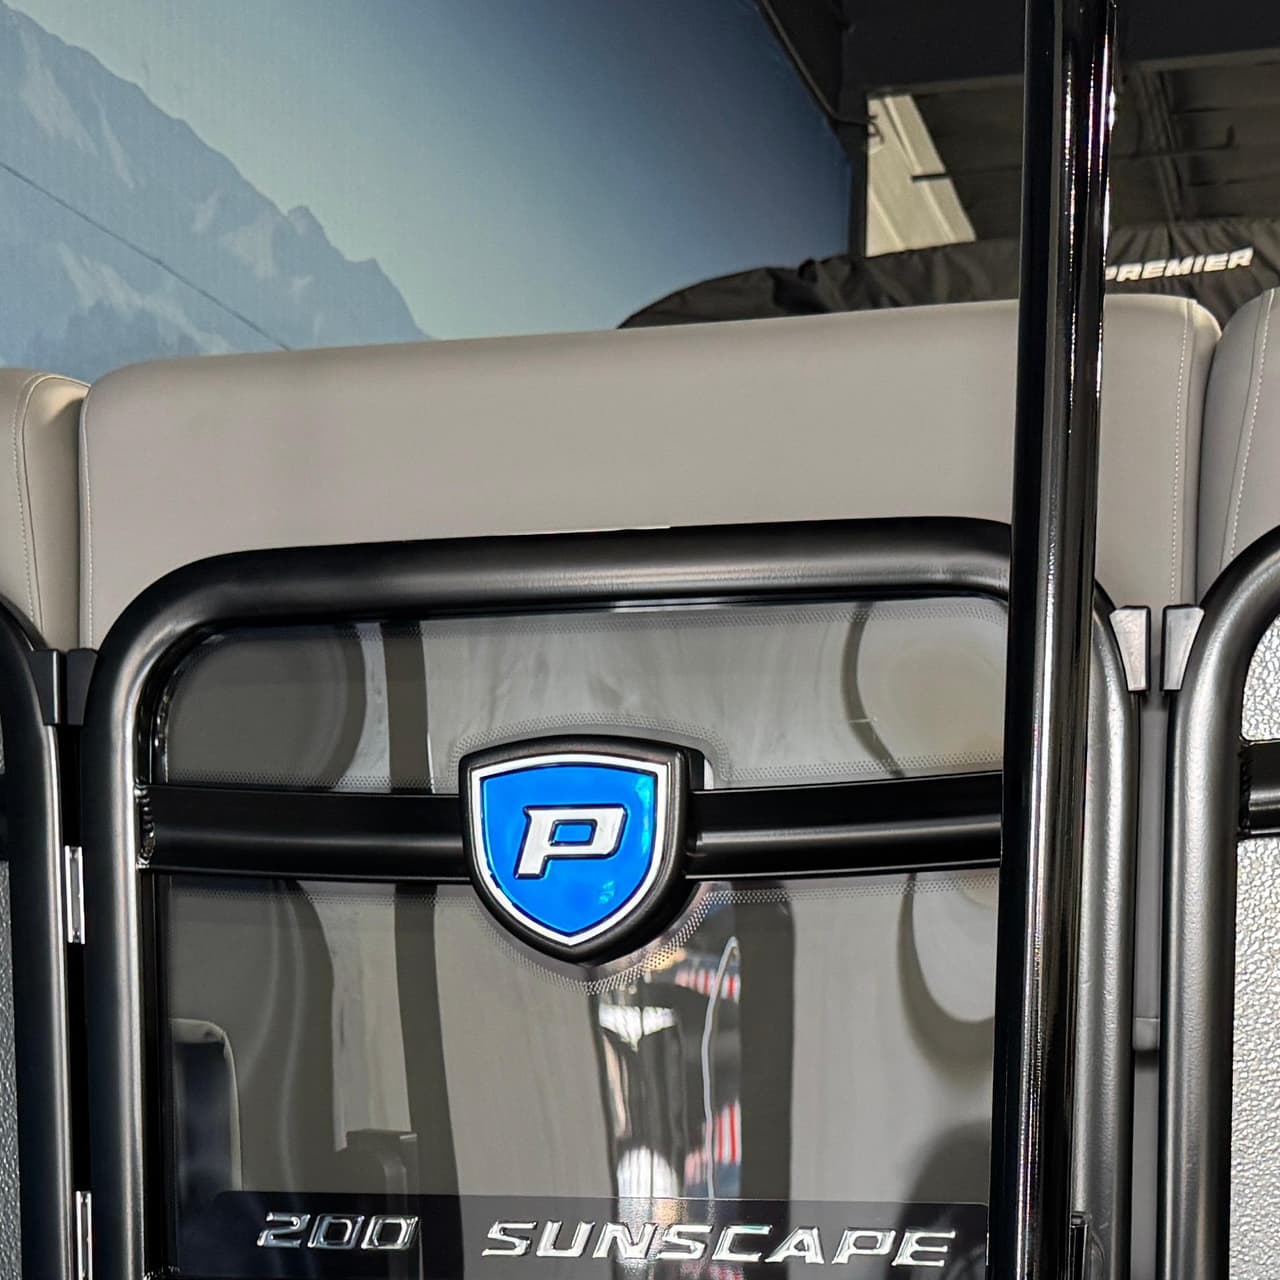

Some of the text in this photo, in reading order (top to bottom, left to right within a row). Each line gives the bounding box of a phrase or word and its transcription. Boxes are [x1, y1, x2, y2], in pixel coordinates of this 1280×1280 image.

[515, 804, 628, 879] P
[256, 1212, 957, 1268] 200 SUNSCAPE
